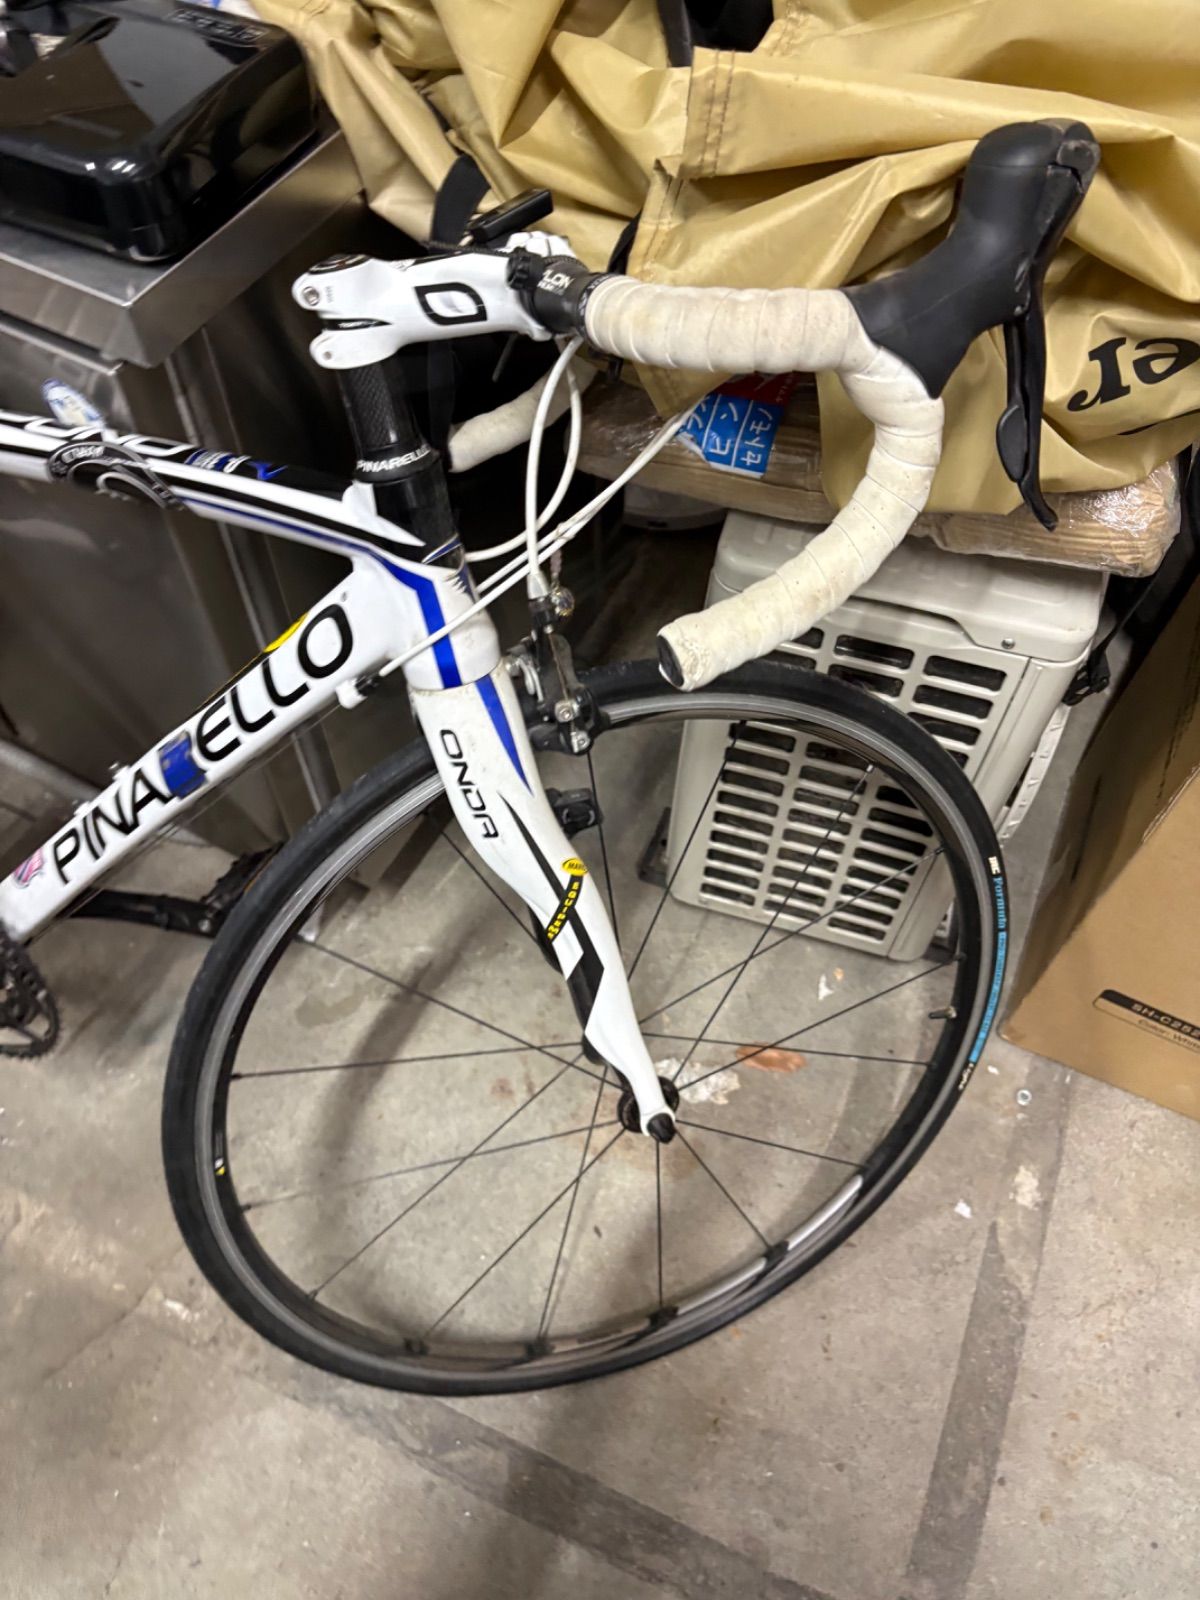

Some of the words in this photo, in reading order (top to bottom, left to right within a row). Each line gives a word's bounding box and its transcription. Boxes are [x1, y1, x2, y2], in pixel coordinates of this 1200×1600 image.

[708, 402, 739, 456] ビン
[740, 407, 773, 467] セトモノ
[50, 603, 353, 884] PINAELLO
[439, 728, 499, 839] ONDA
[992, 876, 1007, 929] Formula
